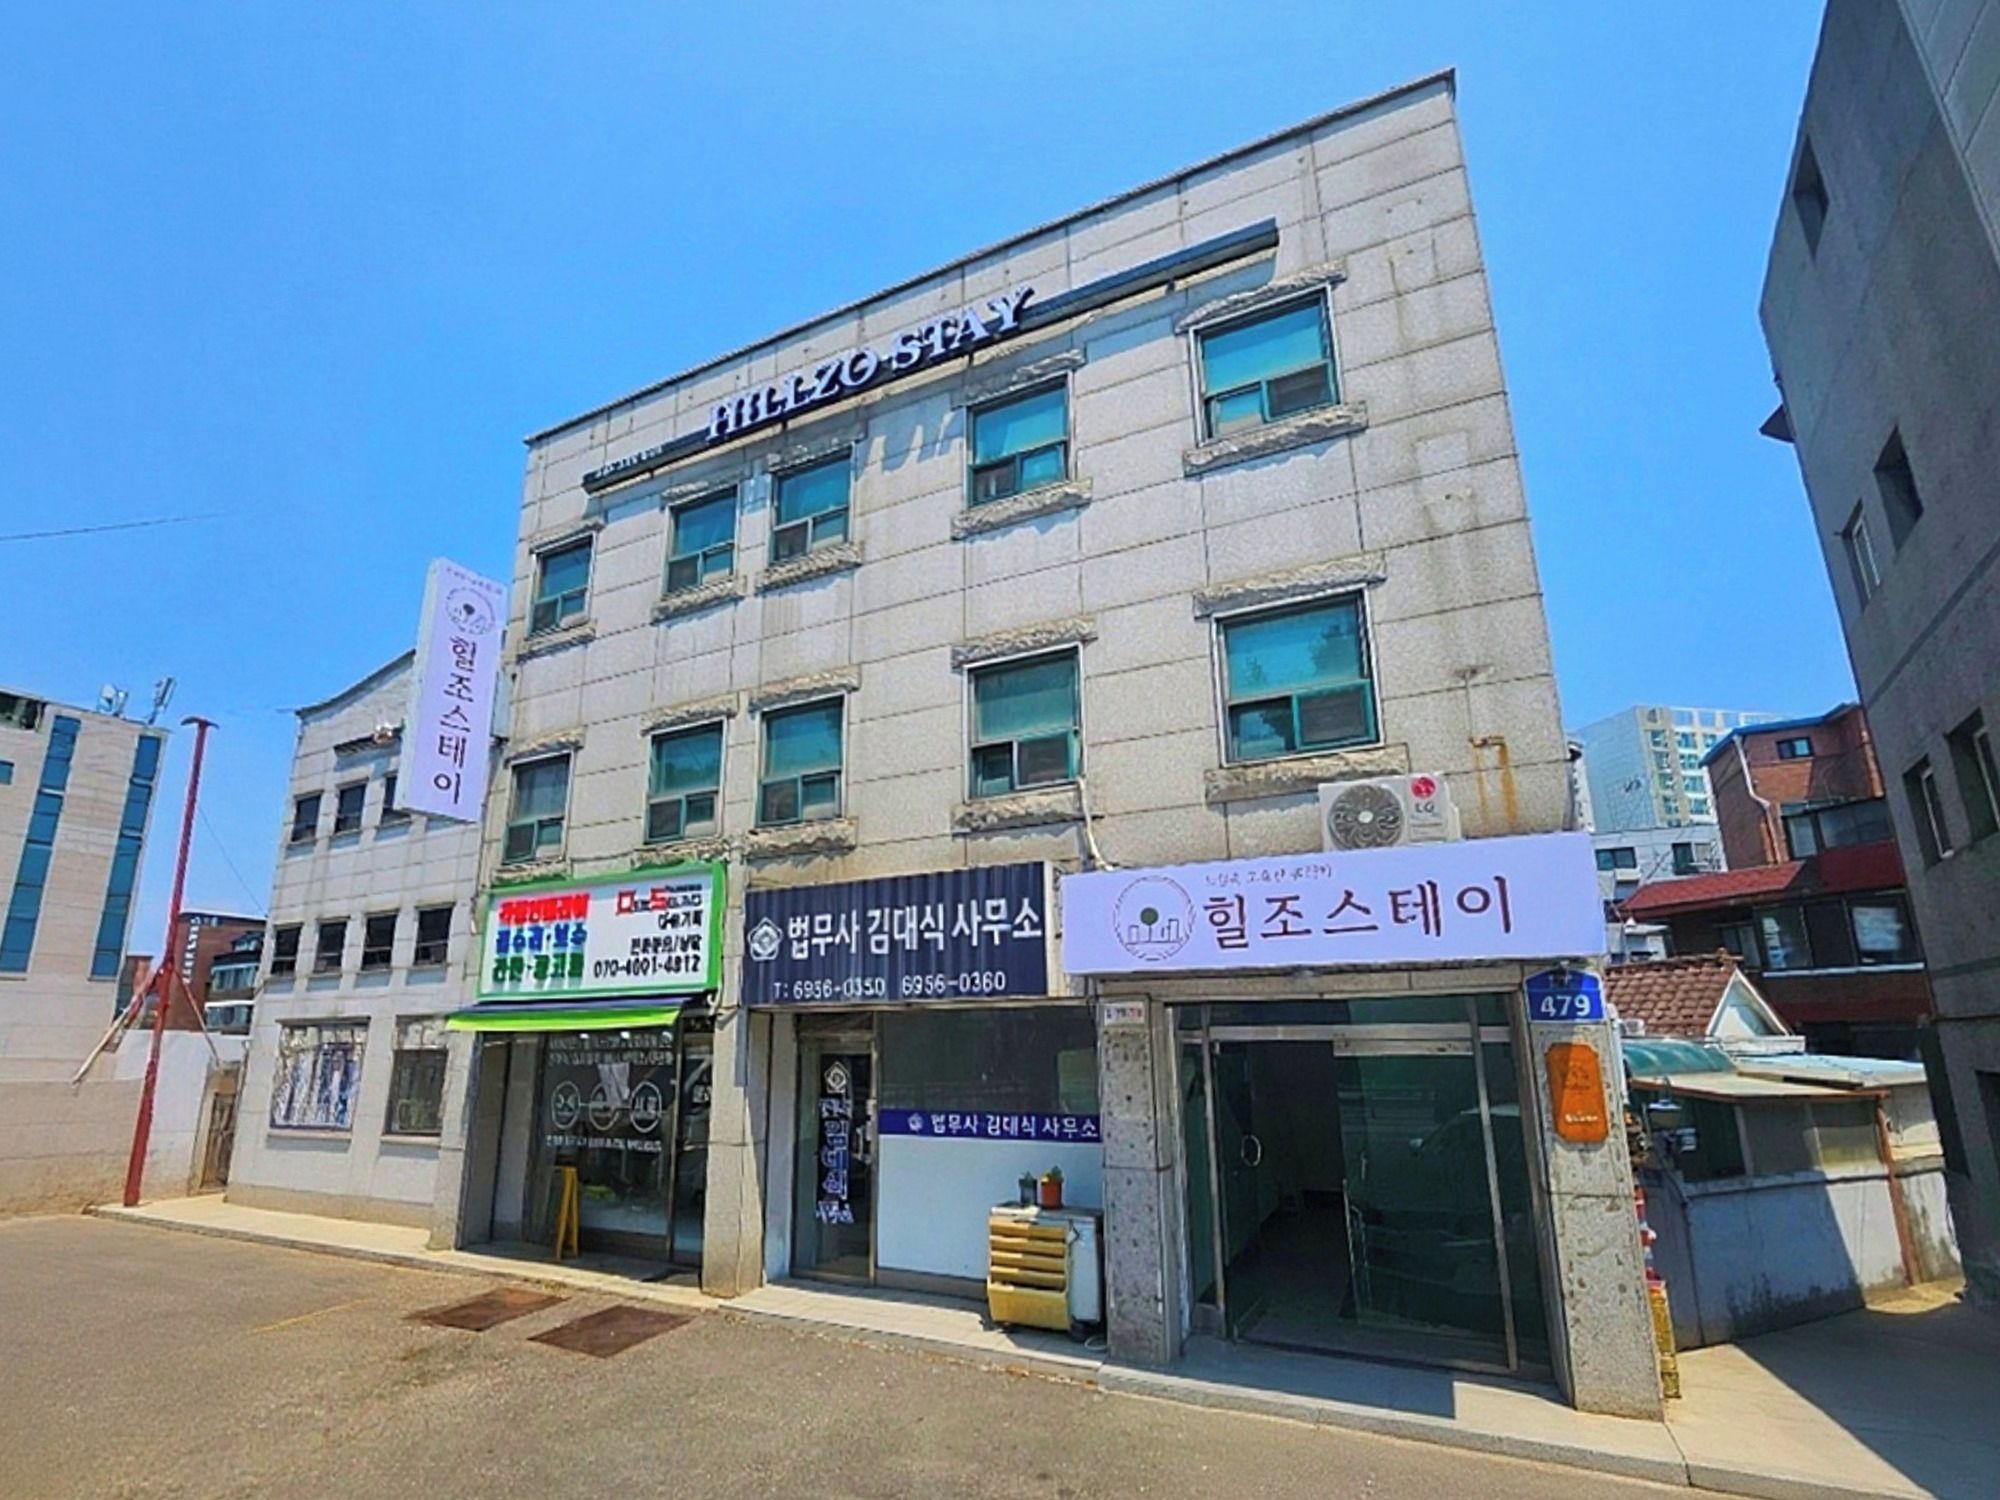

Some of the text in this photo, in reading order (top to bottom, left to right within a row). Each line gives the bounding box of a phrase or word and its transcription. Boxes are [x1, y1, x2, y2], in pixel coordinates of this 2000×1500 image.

[889, 283, 1036, 370] STAY
[433, 634, 478, 805] 힐조스테이
[1415, 802, 1435, 814] LG
[787, 896, 1043, 960] 법무사 김대식 사무소
[1202, 875, 1513, 951] 힐조스테이
[902, 971, 1006, 996] 6956-0360
[1540, 994, 1592, 1018] 479
[930, 1113, 1099, 1139] 법무사 김대식 사무소
